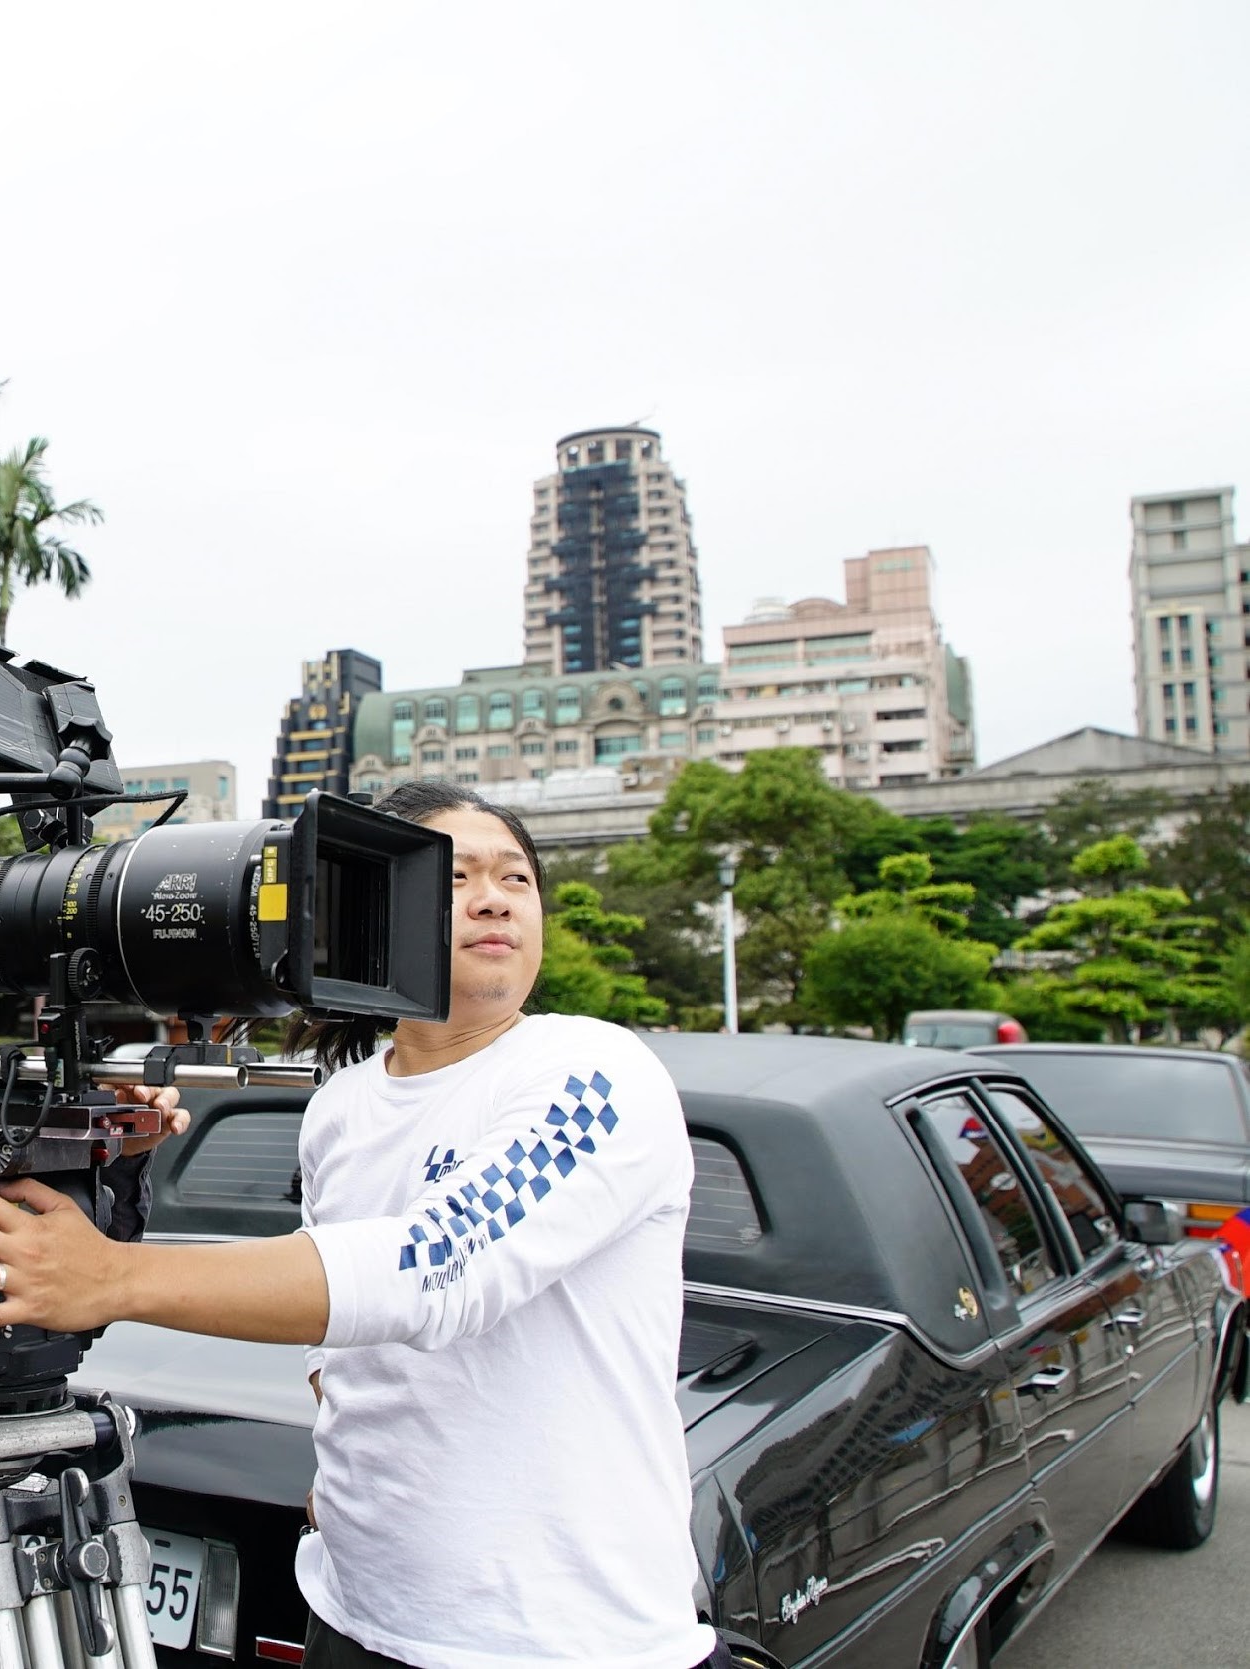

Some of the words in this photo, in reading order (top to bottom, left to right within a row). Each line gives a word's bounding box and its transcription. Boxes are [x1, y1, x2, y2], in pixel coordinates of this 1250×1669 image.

[155, 873, 197, 891] ARRI
[145, 903, 201, 922] 45-250
[146, 1563, 193, 1621] 55
